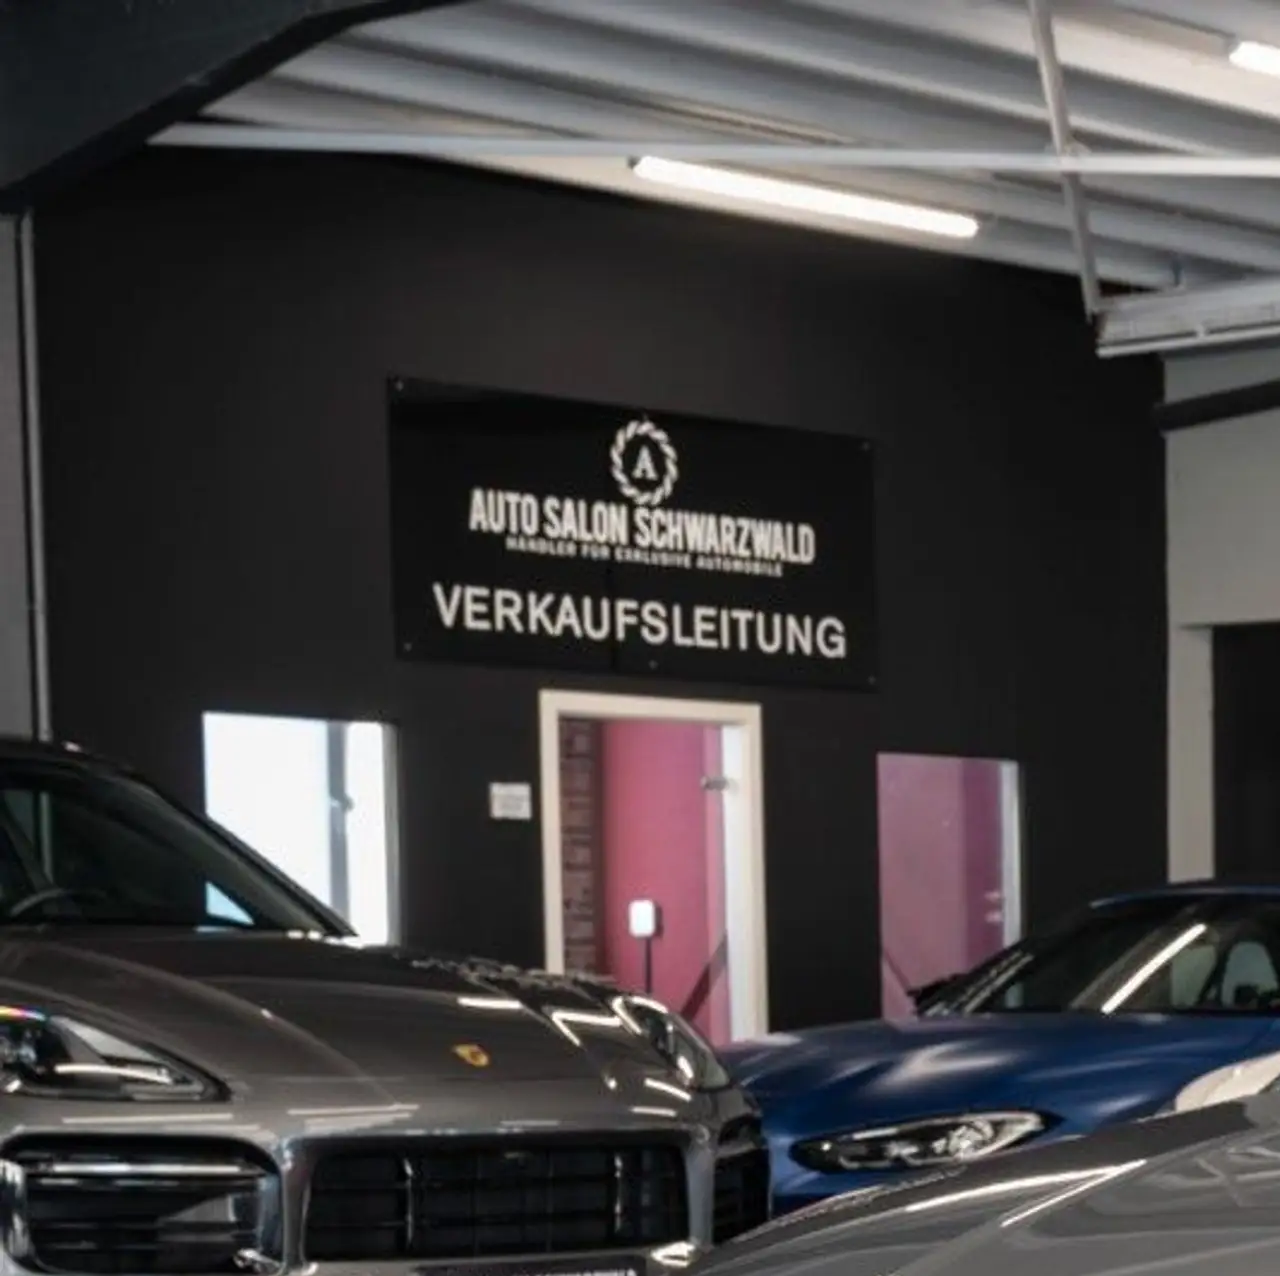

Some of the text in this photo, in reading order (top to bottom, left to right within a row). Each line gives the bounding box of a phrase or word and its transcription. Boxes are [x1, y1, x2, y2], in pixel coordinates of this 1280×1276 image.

[469, 488, 816, 565] AUTO SALON SCHWARZWALD
[433, 582, 847, 659] VERKAUFSLEITUNG
